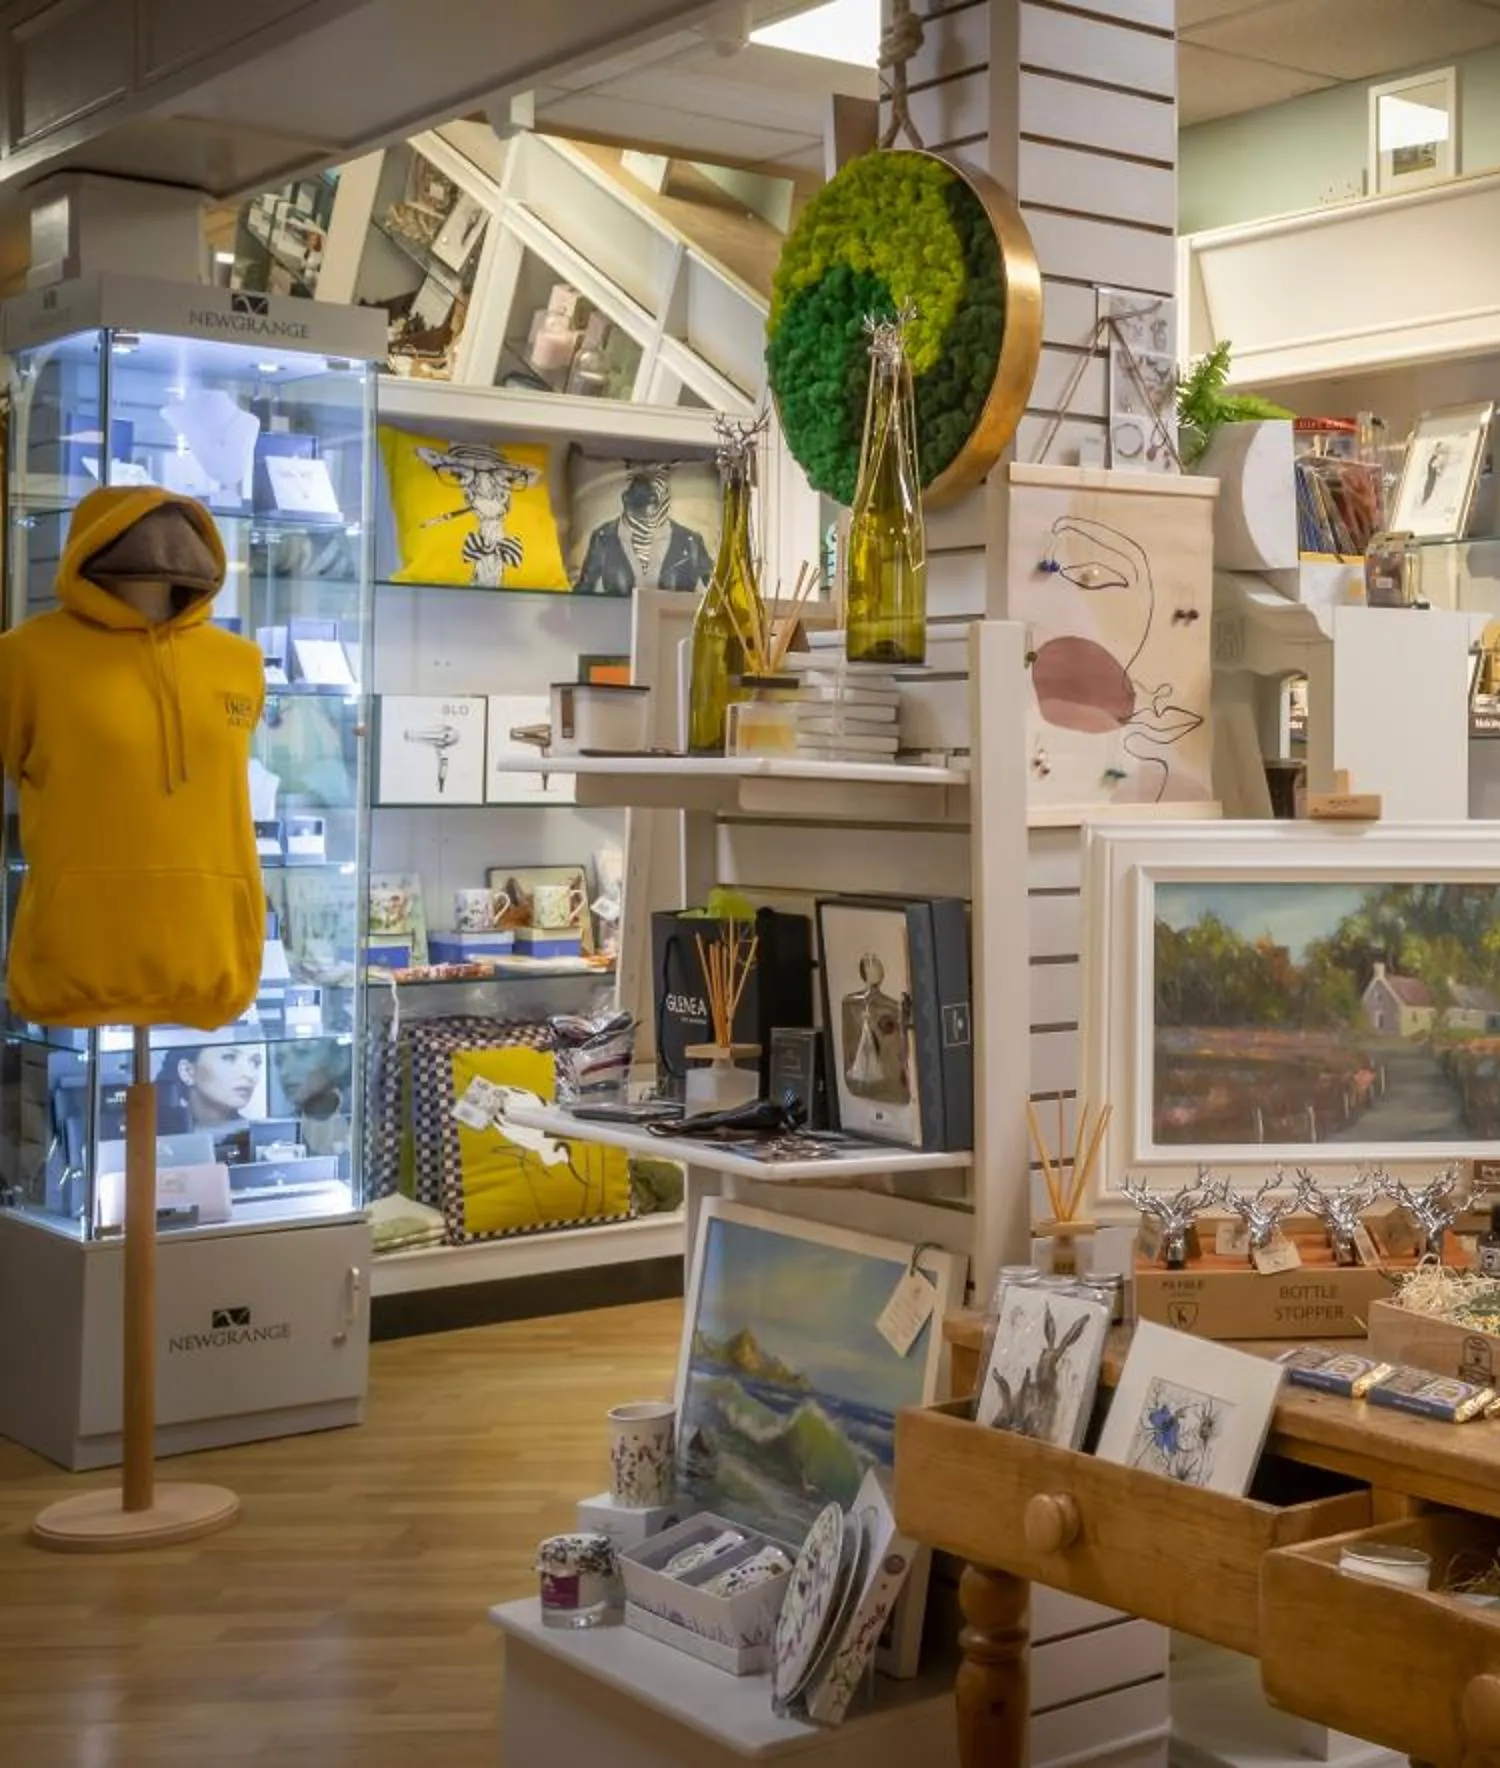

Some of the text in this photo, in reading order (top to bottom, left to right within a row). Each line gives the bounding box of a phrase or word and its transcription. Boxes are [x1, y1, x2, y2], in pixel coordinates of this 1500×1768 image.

[188, 310, 310, 338] NEWGRANGE
[665, 993, 708, 1016] GLENEA
[1278, 1284, 1340, 1300] BOTTLE
[1273, 1304, 1345, 1322] STOPPER
[168, 1322, 291, 1353] NEWGRANGE
